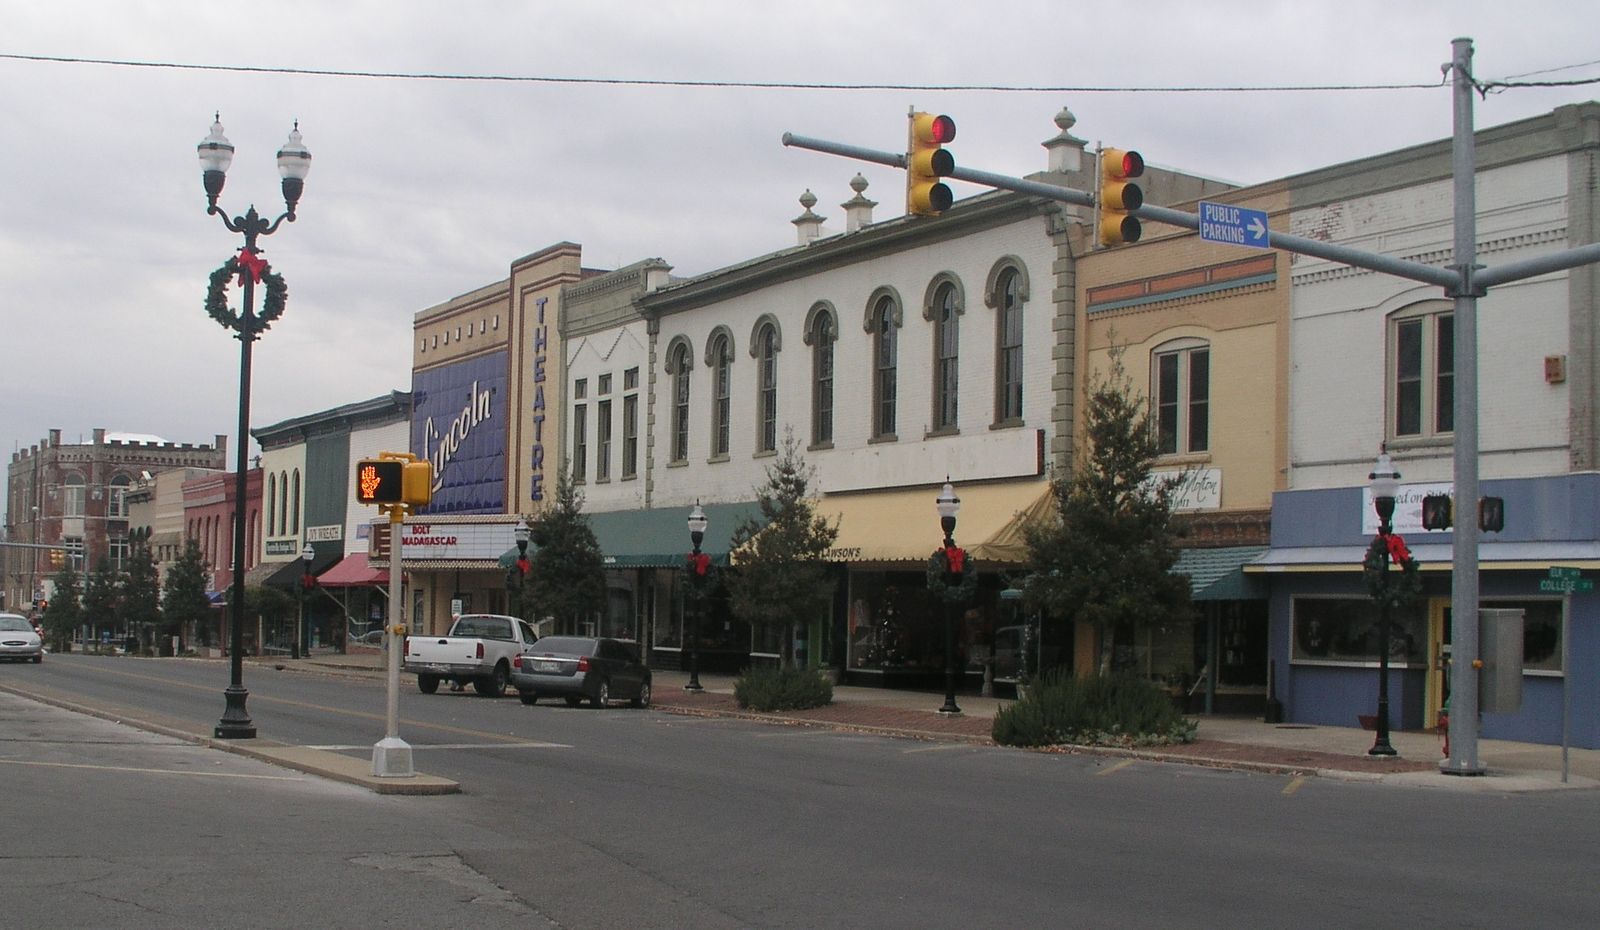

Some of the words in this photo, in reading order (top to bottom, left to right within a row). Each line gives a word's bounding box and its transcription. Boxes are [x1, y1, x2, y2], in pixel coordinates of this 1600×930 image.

[1205, 204, 1241, 225] PUBLIC
[1202, 222, 1245, 244] PARKING
[531, 296, 549, 501] THEATRE
[424, 380, 492, 494] Lincoln
[319, 526, 340, 539] WREATH
[412, 525, 431, 535] BOLT
[401, 536, 457, 546] MADAGASCAR
